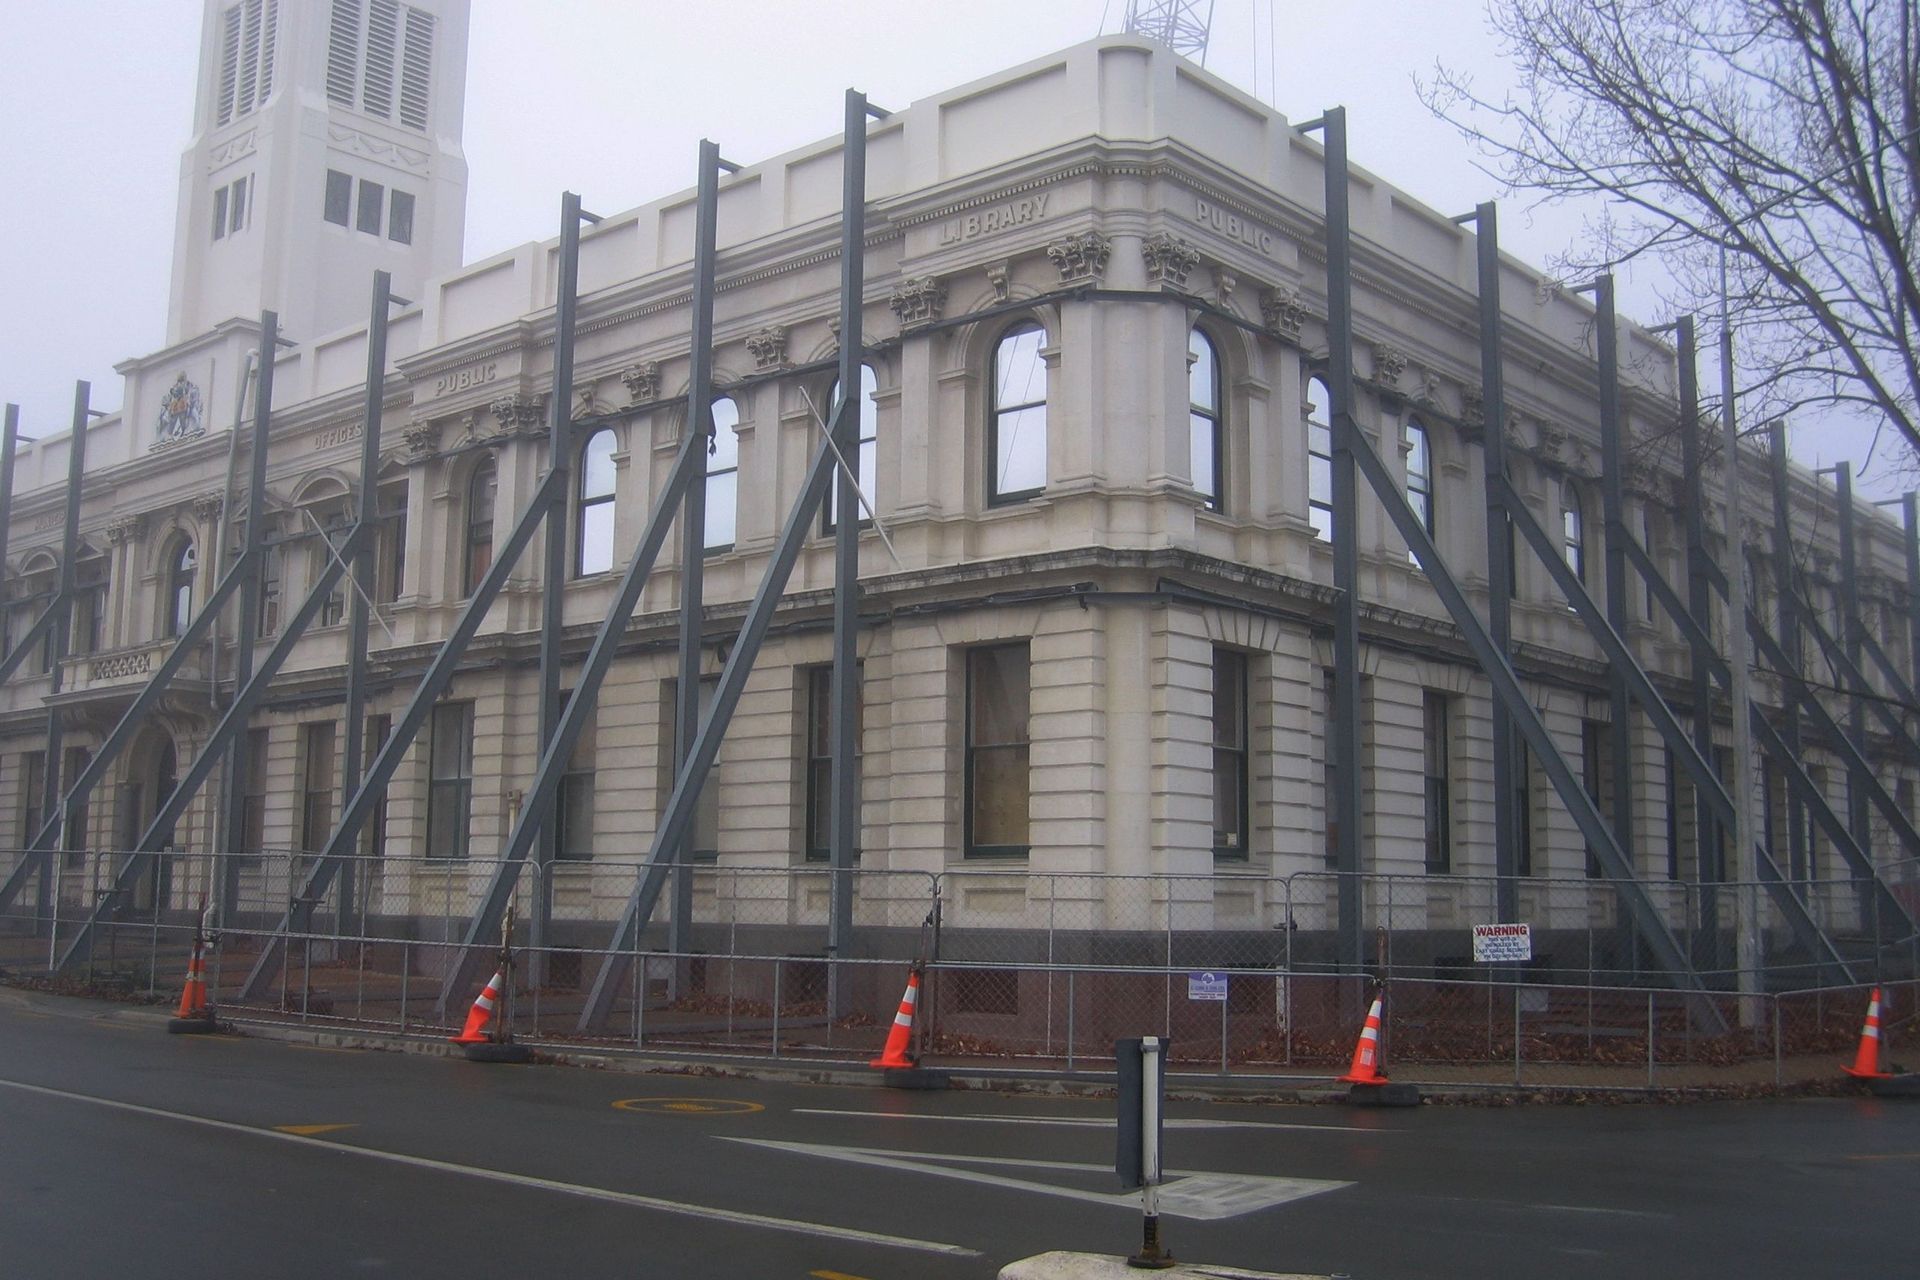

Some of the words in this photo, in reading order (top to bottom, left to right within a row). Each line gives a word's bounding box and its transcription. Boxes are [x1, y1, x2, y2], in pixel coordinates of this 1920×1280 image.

[941, 193, 1050, 246] LIBRARY
[1196, 199, 1272, 255] PUBLIC
[434, 363, 496, 397] PUBLIC
[313, 424, 363, 450] OFFICES
[1476, 926, 1527, 936] WARNING
